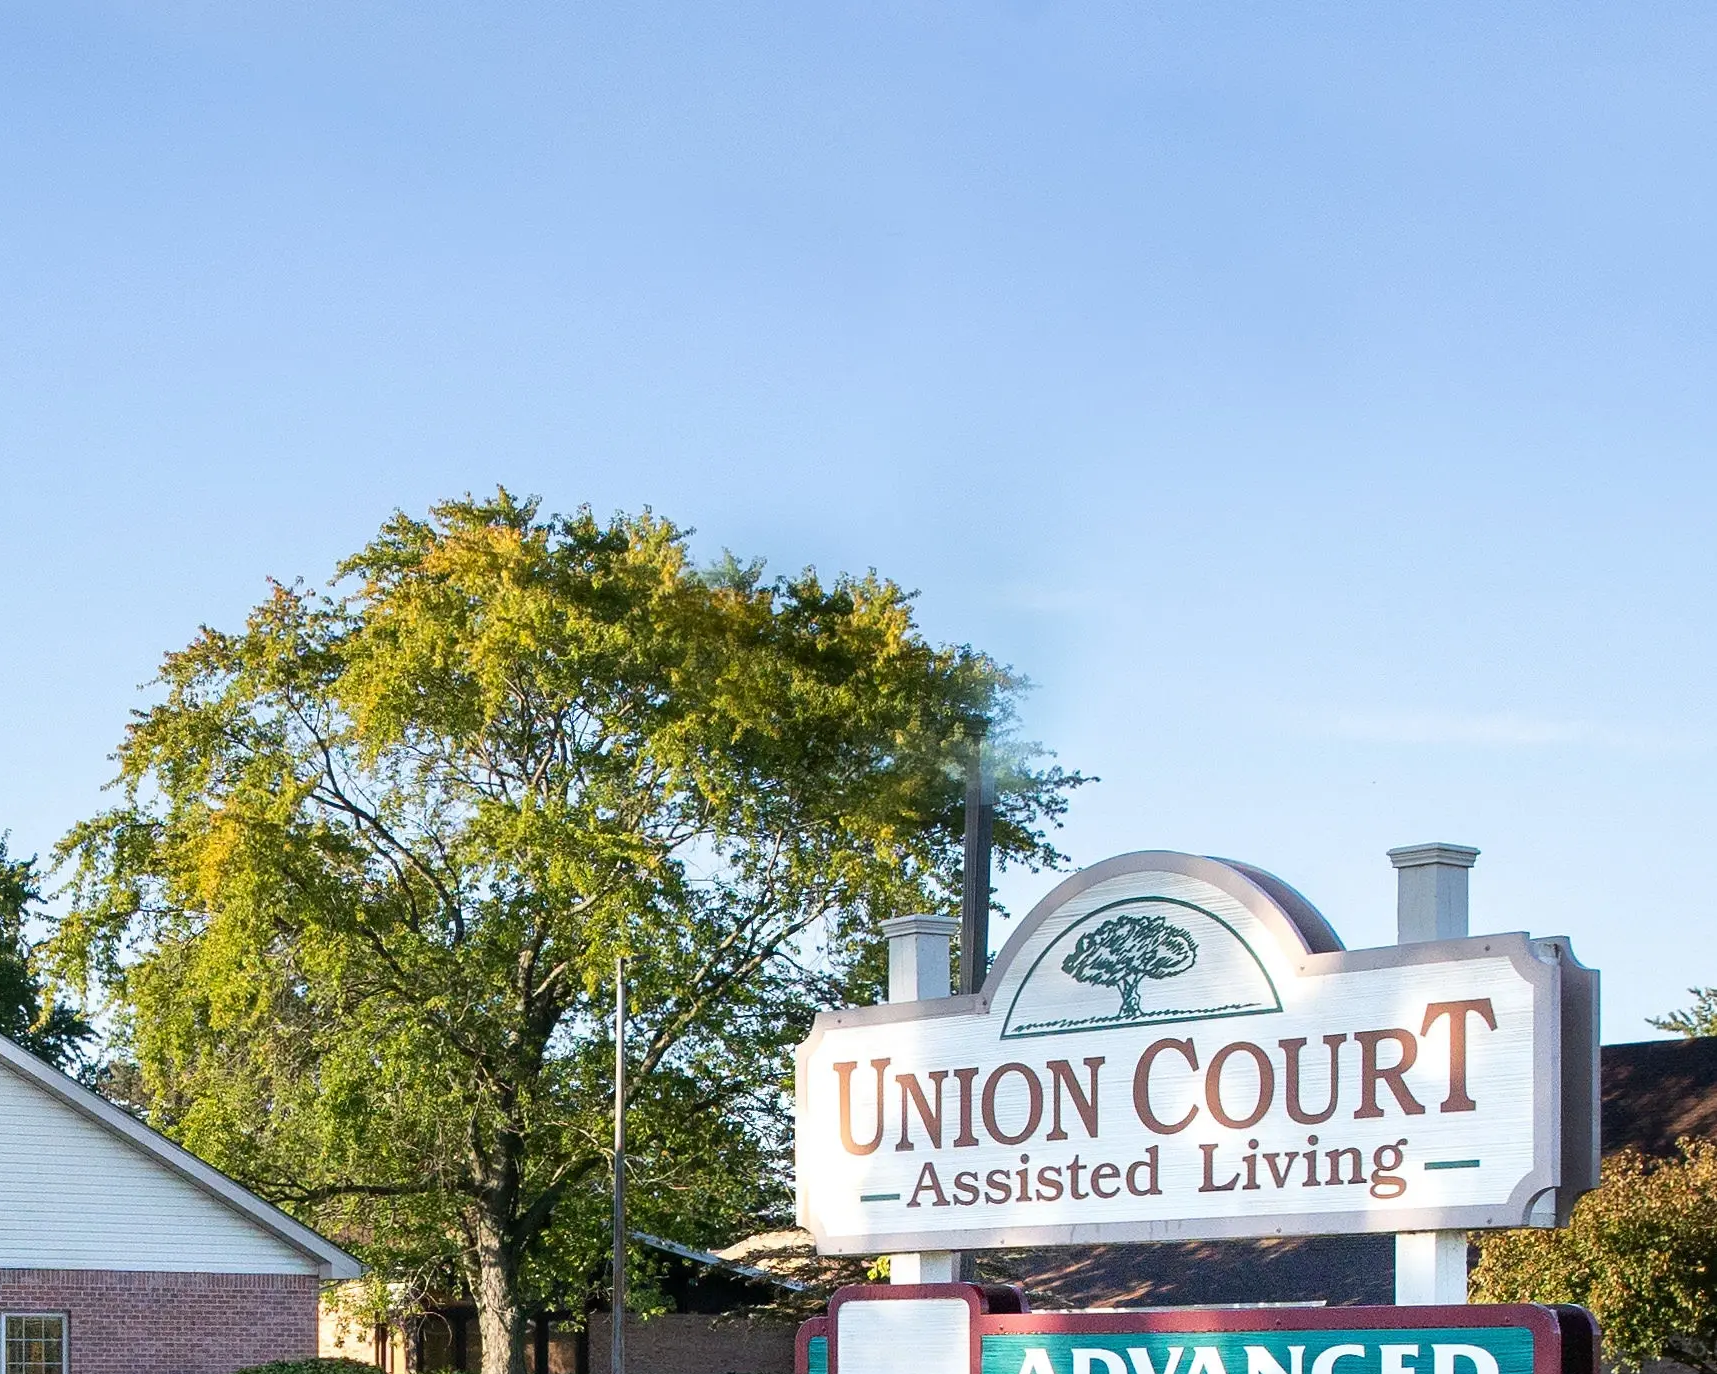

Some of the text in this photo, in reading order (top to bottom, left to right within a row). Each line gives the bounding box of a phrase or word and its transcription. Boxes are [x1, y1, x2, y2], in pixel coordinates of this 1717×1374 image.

[833, 997, 1498, 1156] UNION COURT
[906, 1134, 1408, 1207] Assisted Living
